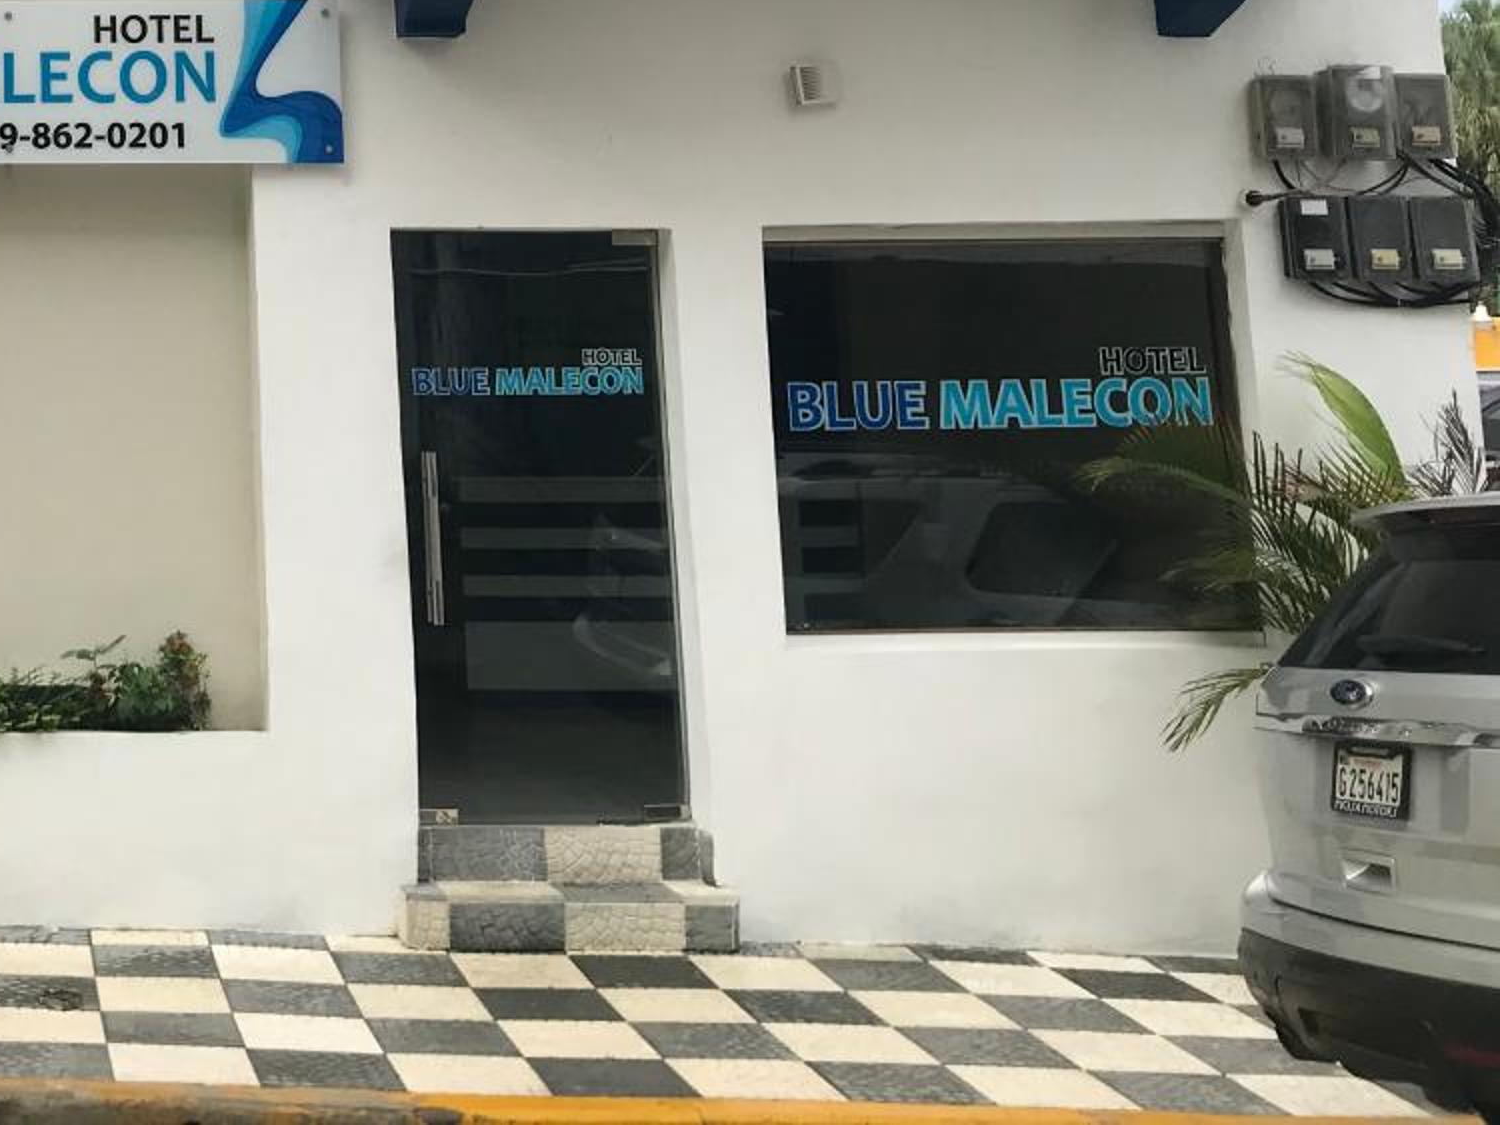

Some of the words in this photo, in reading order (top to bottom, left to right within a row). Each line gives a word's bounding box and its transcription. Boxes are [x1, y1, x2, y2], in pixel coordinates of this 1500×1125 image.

[93, 14, 215, 45] HOTEL
[581, 347, 643, 366] HOTEL
[1100, 346, 1206, 375] HOTEL
[411, 367, 490, 396] BLUE
[495, 366, 645, 396] MALECON
[786, 380, 930, 432] BLUE
[939, 376, 1214, 430] MALECON
[1338, 766, 1399, 804] G256415
